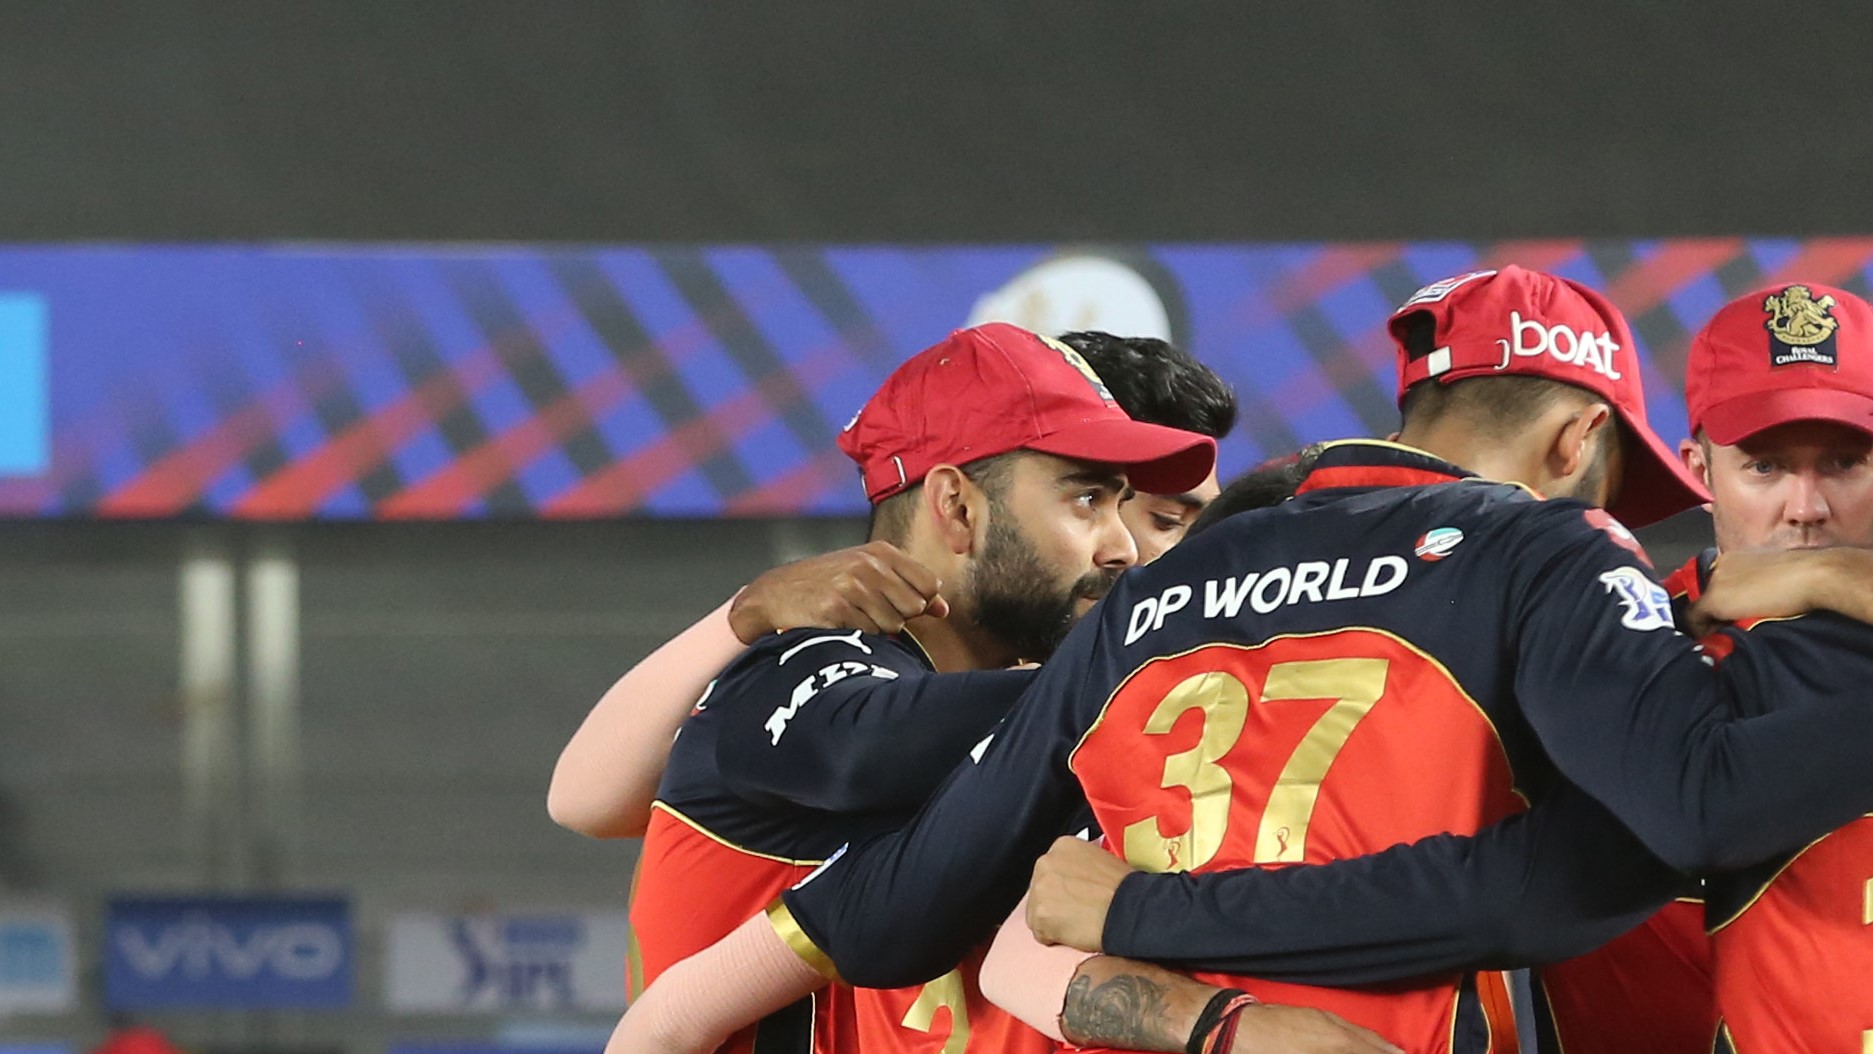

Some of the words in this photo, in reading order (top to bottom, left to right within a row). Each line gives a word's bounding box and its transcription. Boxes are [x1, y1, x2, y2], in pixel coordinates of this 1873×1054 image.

[1124, 585, 1191, 646] DP
[1203, 556, 1409, 619] WORLD
[1123, 657, 1390, 875] 37
